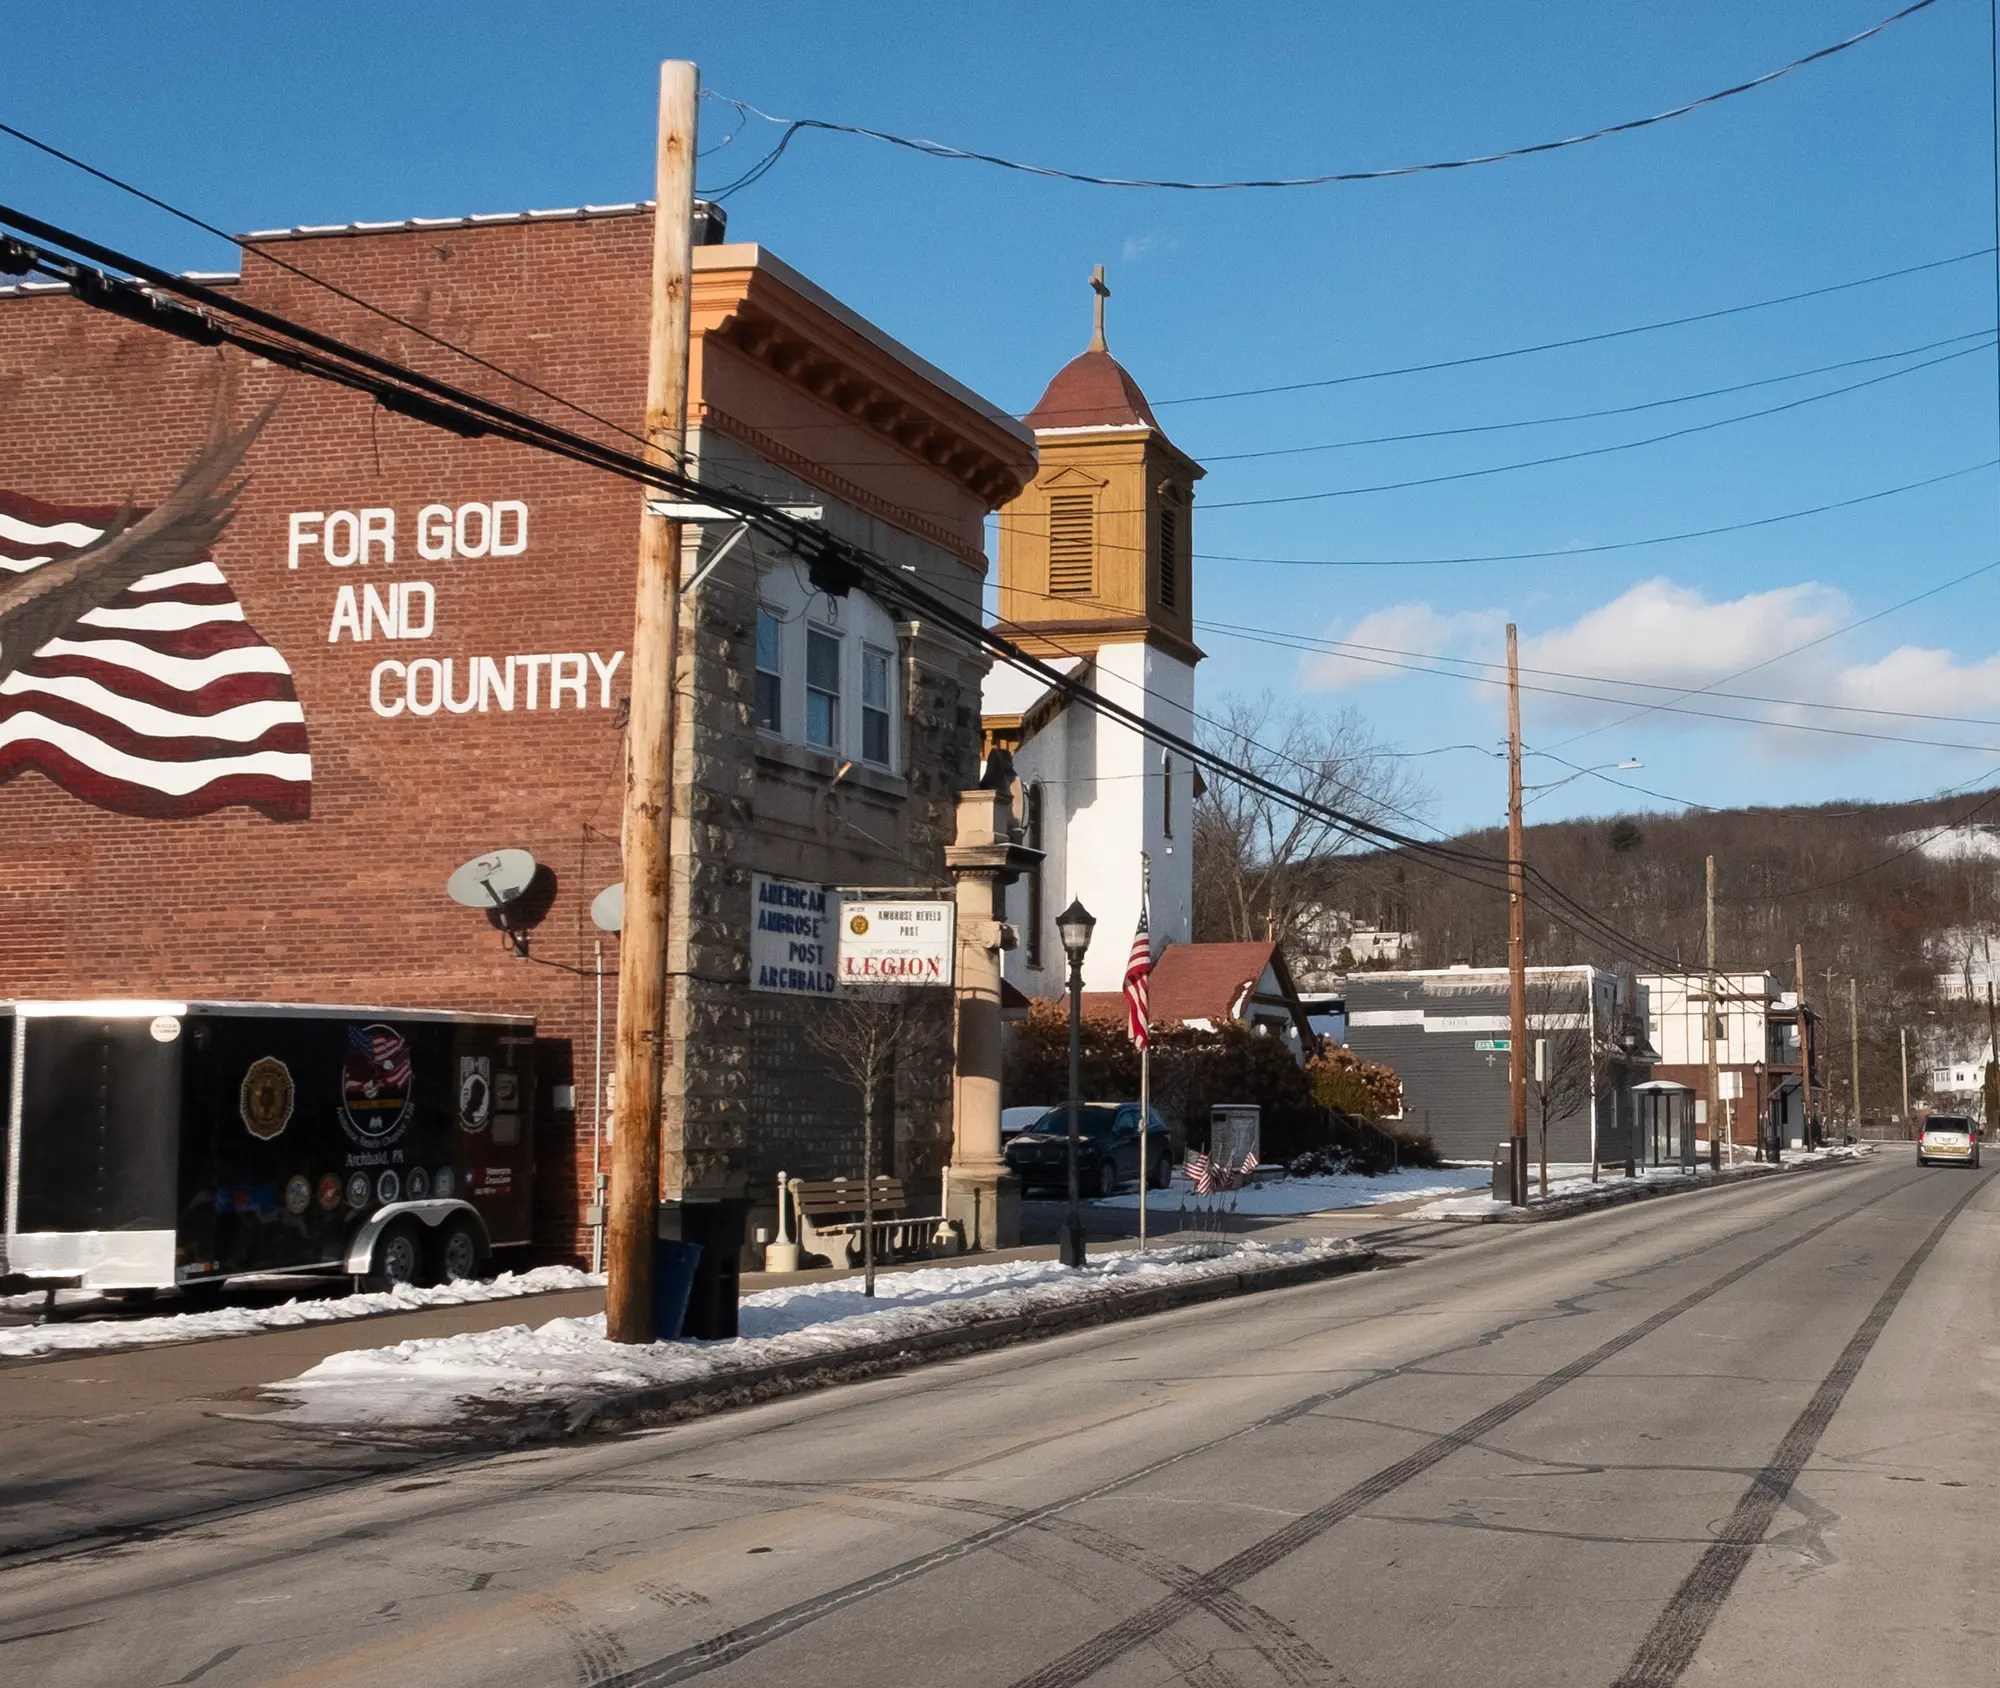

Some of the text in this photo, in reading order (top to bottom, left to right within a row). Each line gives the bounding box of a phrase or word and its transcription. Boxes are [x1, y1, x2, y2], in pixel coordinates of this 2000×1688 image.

[289, 500, 528, 569] FOR GOD
[328, 581, 435, 642] AND
[370, 650, 626, 718] COUNTRY
[759, 882, 826, 914] AMERICAN
[758, 909, 821, 938] AMBROSE
[878, 911, 942, 921] AMBROSE REVELS
[900, 926, 919, 936] POST
[788, 941, 825, 965] POST
[844, 957, 940, 977] LEGION
[759, 966, 835, 993] ARCHBALD
